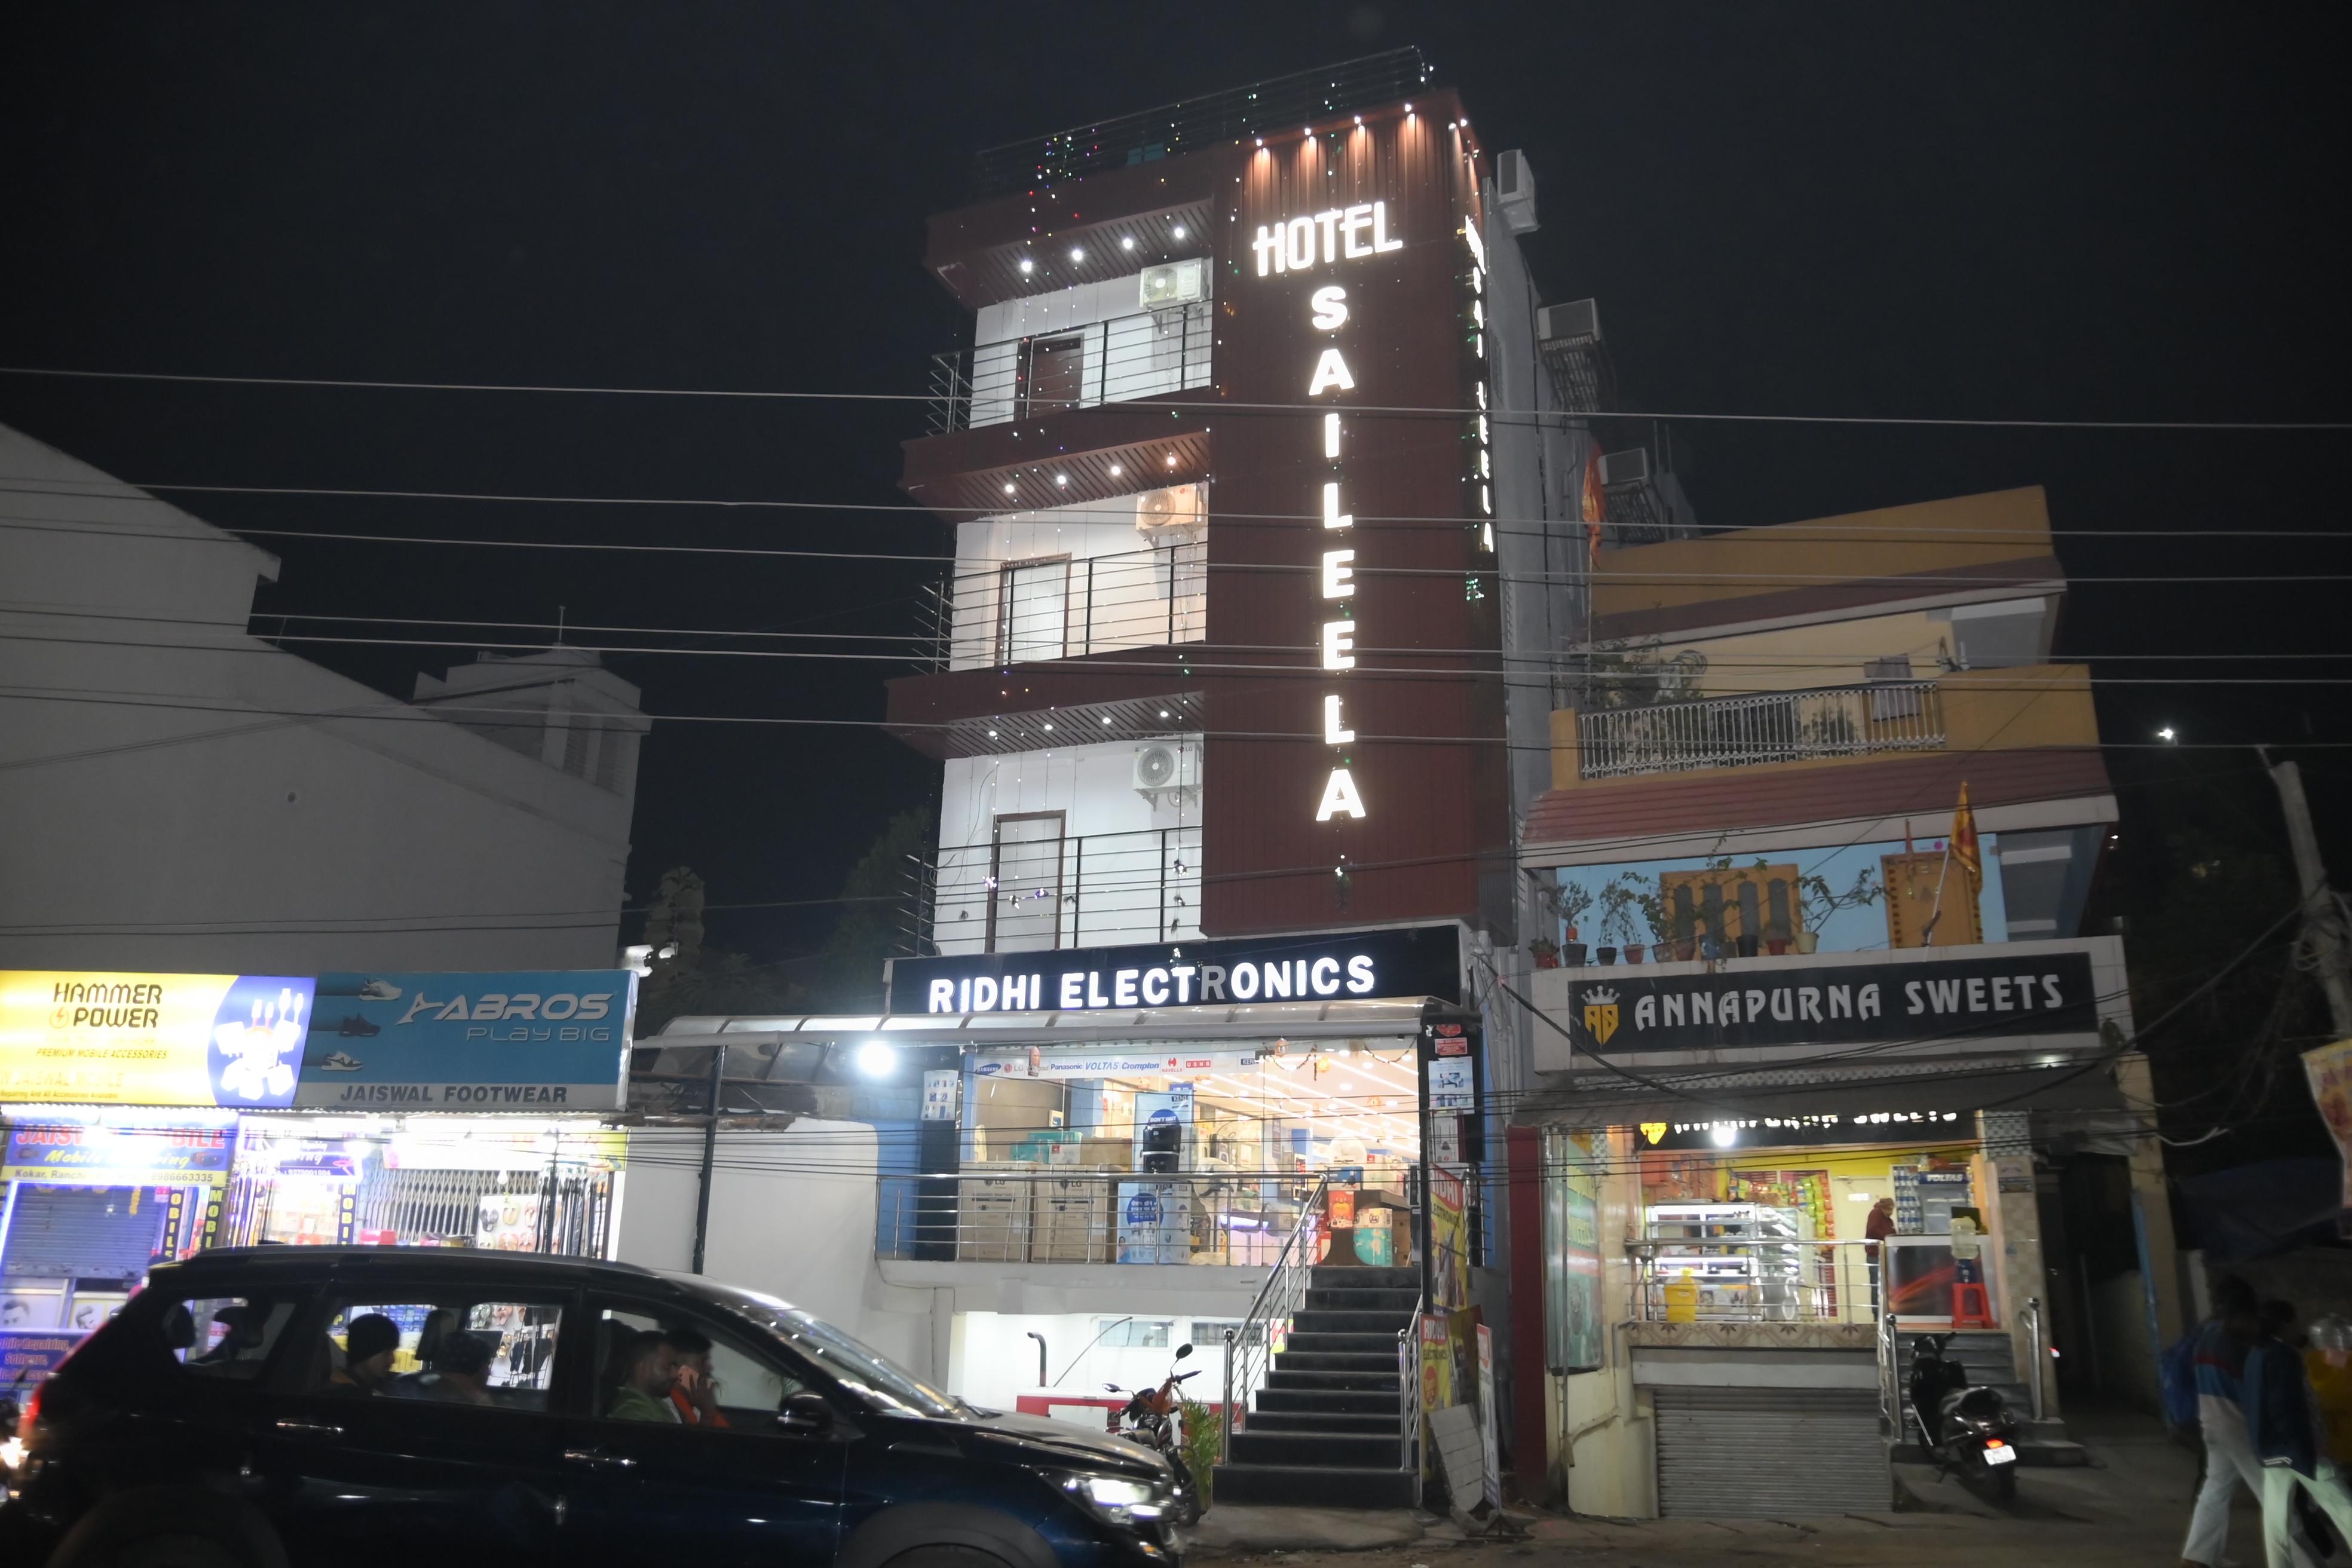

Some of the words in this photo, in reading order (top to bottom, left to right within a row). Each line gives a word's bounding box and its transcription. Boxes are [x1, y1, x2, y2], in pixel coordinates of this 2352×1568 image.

[1252, 201, 1402, 277] HOTEL
[1309, 286, 1366, 821] SAILEELA
[54, 982, 163, 1004] HAMMER
[929, 973, 1040, 1013] RIDHI
[1061, 954, 1375, 1009] ELECTRONICS
[433, 993, 614, 1020] ABROS
[1635, 983, 1882, 1031] ANNAPURNA
[1906, 975, 2063, 1015] SWEETS
[73, 1007, 158, 1028] POWER
[559, 1027, 611, 1042] BIG
[36, 1048, 74, 1057] PREMIUM
[77, 1049, 108, 1058] MOBILE
[110, 1049, 167, 1059] ACCESSORIES
[1085, 1061, 1119, 1070] VOLTAS
[1122, 1062, 1159, 1071] Crompton
[341, 1085, 433, 1102] JAISWAL
[444, 1086, 567, 1103] FOOTWEAR
[15, 1169, 47, 1180] Kokar,
[1431, 1203, 1460, 1228] LECTRONICS
[1424, 1319, 1446, 1339] RIDHI
